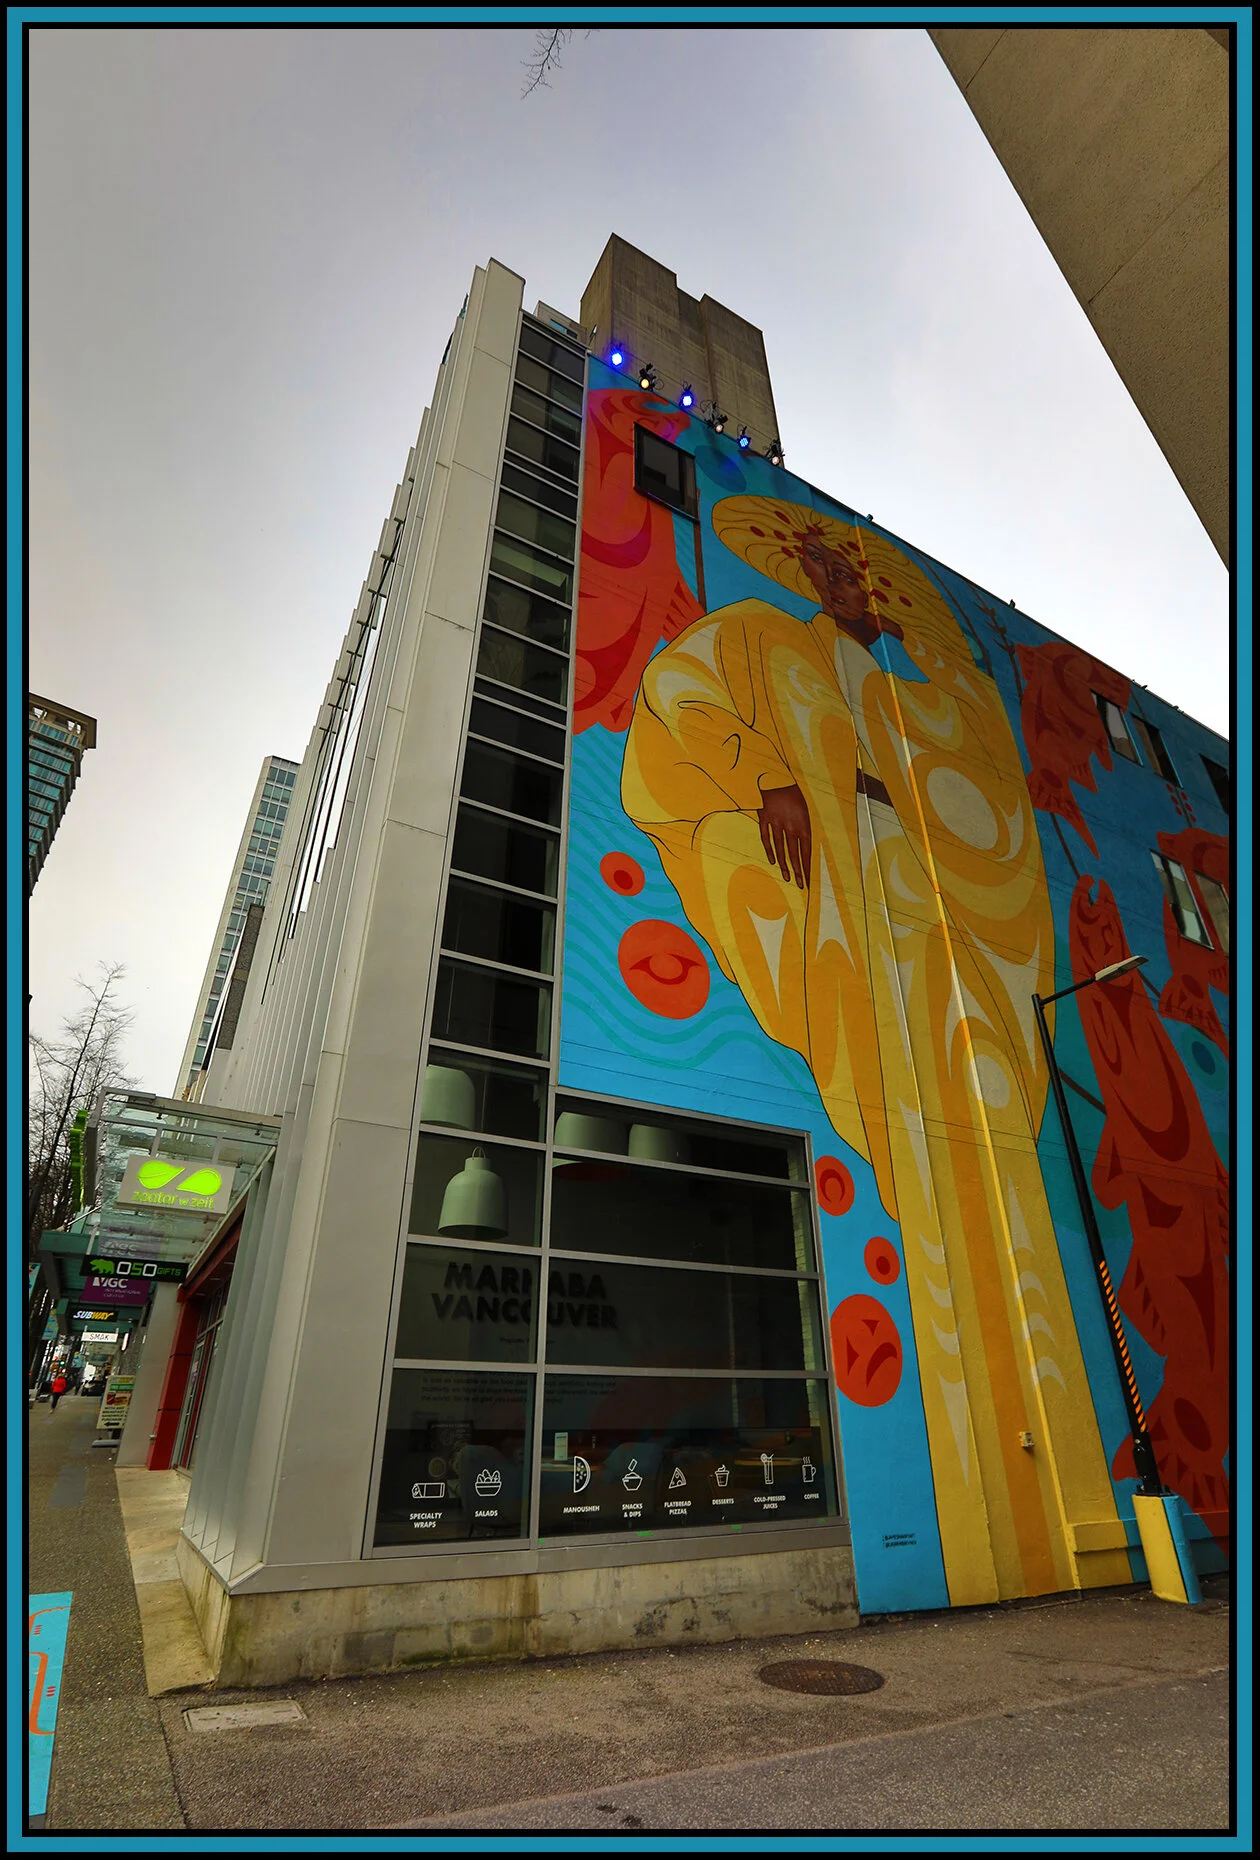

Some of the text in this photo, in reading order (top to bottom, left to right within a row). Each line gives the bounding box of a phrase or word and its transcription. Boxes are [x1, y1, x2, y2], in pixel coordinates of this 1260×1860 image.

[132, 1190, 215, 1210] zaatar w zeit
[116, 1260, 182, 1277] OSO GIFTS
[73, 1310, 114, 1320] SUBWAY
[712, 1498, 734, 1506] DESSERTS
[753, 1495, 786, 1503] COLD-PRESSED
[664, 1500, 692, 1508] FLATBREAD
[474, 1509, 499, 1518] SALADS
[563, 1505, 600, 1514] MANOUSHEH
[669, 1508, 688, 1516] PIZZAS
[409, 1512, 442, 1521] SPECIALTY
[413, 1521, 436, 1529] WRAPS
